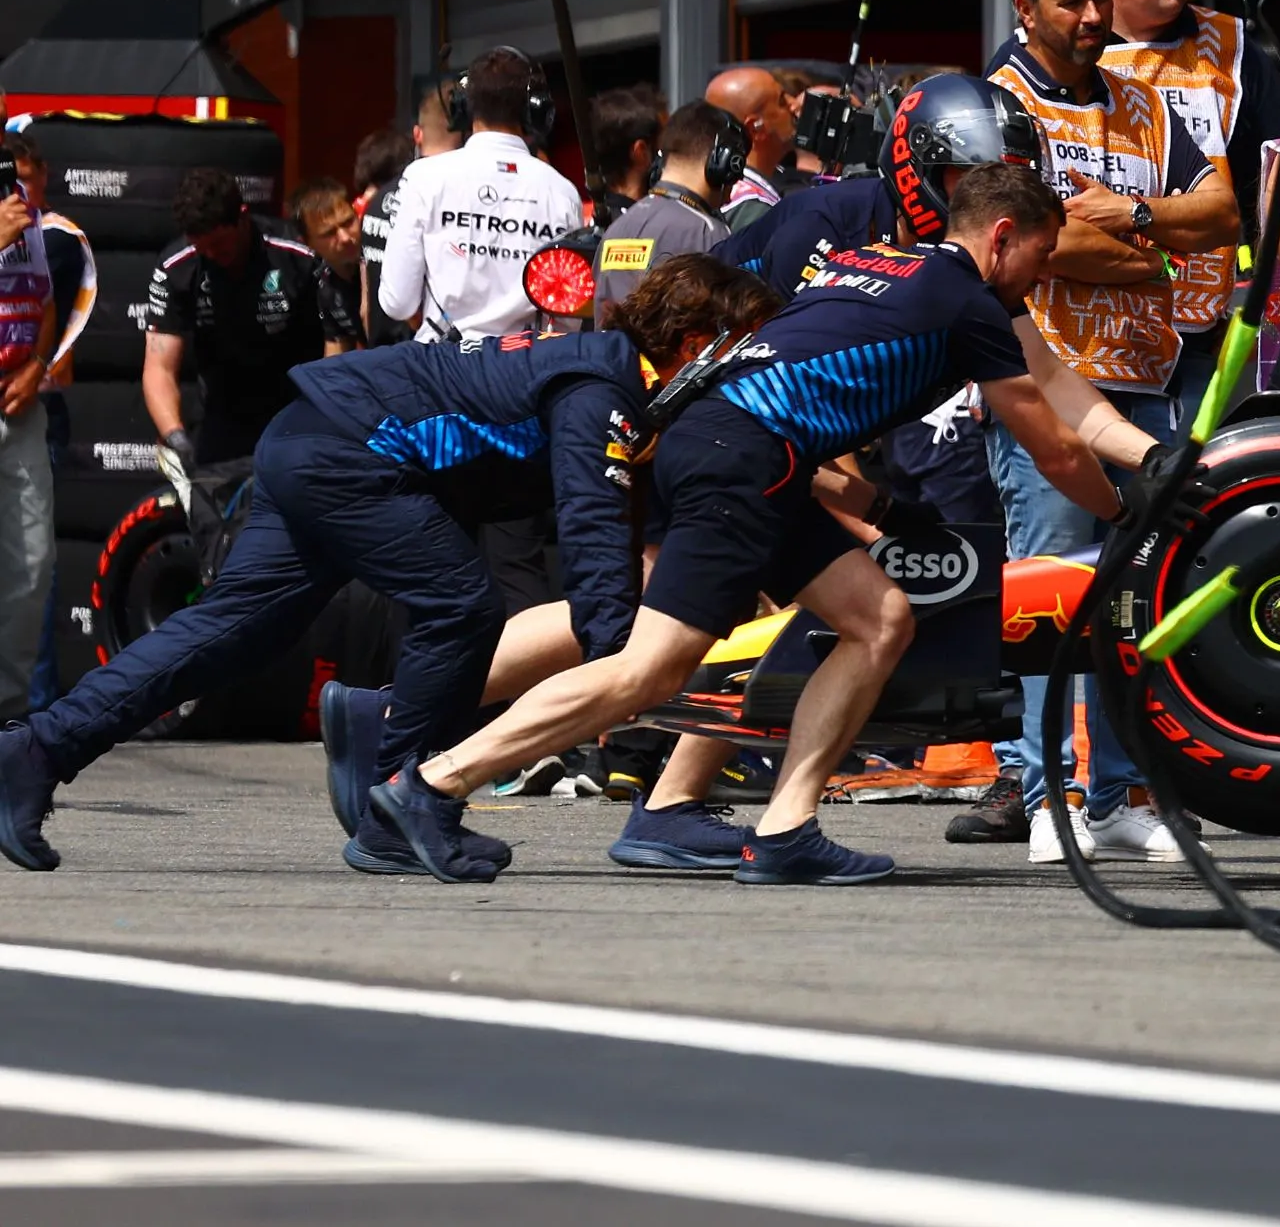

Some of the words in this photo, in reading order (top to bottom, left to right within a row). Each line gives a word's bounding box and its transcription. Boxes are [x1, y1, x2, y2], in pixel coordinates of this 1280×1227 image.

[893, 90, 923, 164] Red
[1056, 143, 1126, 172] 008-EL
[895, 165, 943, 236] Bull
[441, 210, 569, 240] PETRONAS
[459, 242, 530, 261] CROWDST
[832, 250, 874, 272] Red
[875, 255, 927, 278] Bull
[810, 270, 862, 289] Mobil
[884, 546, 961, 579] Esso
